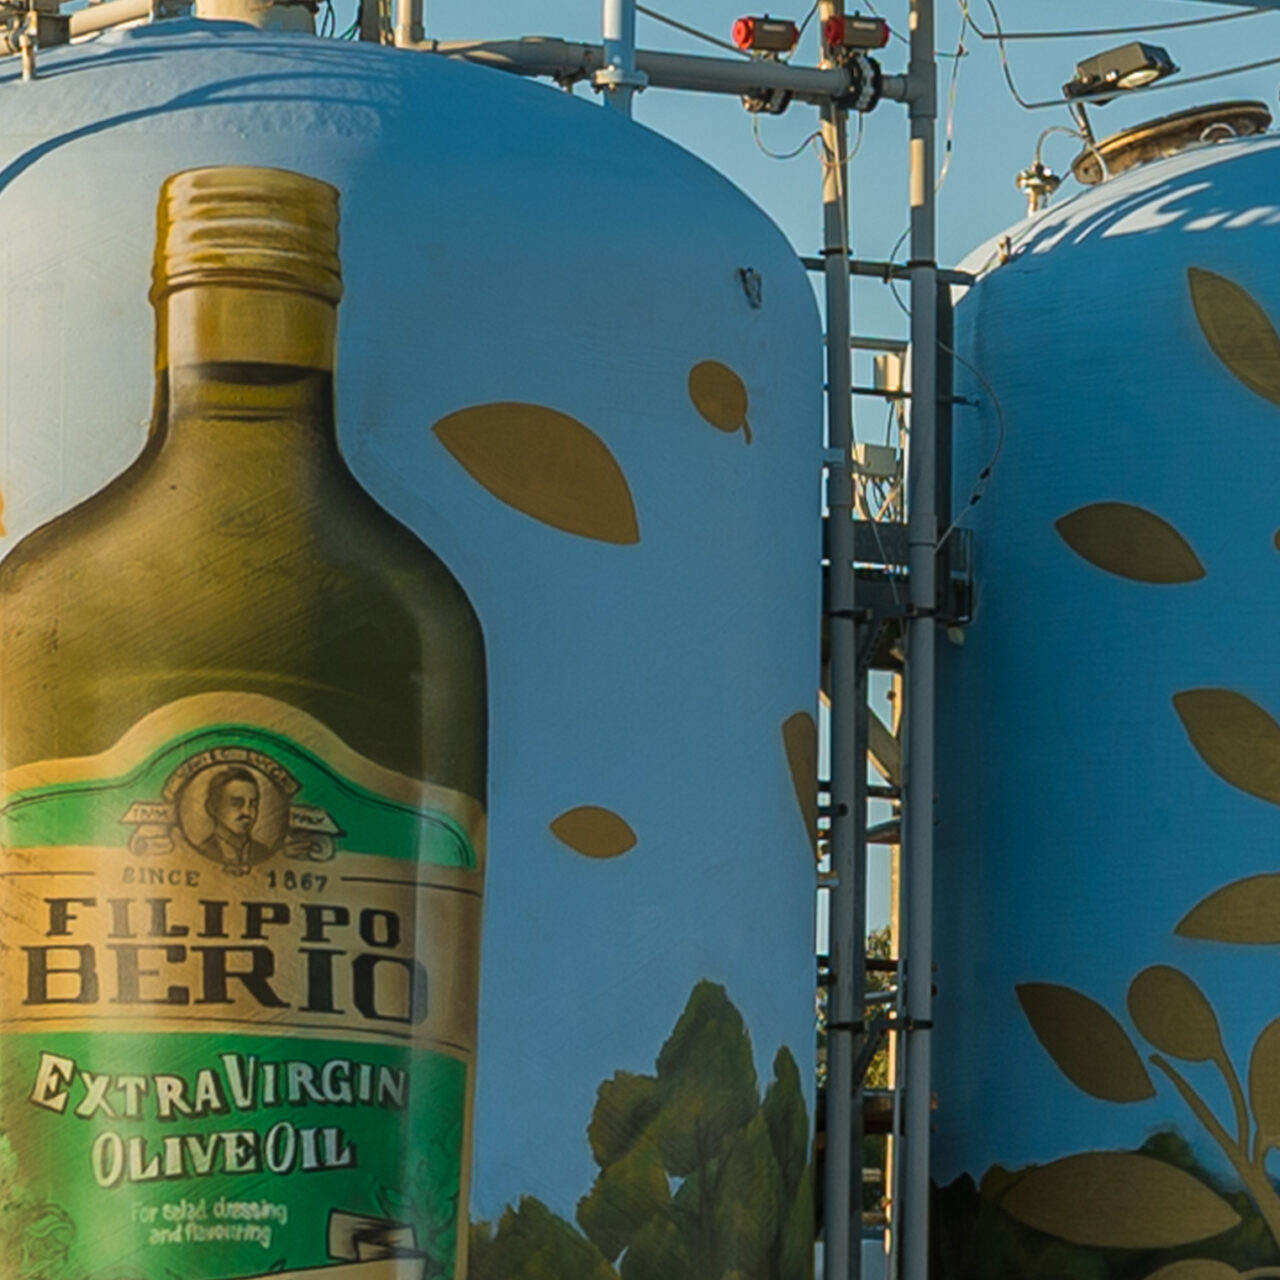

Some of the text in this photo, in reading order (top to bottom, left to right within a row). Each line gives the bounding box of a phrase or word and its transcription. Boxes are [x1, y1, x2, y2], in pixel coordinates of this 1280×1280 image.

[122, 866, 328, 892] SINCE 1867
[43, 897, 402, 949] FILIPPO
[21, 943, 430, 1026] BERIO
[213, 1196, 288, 1226] dressing
[149, 1224, 182, 1245] and
